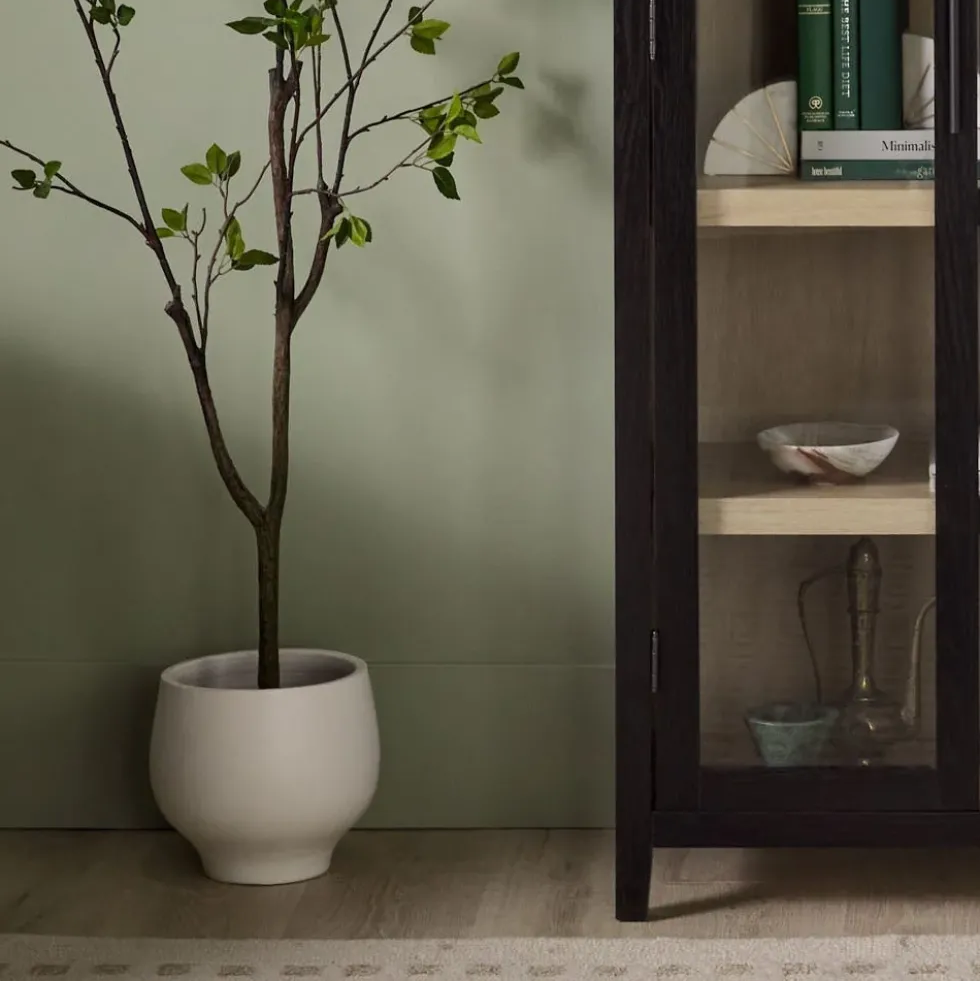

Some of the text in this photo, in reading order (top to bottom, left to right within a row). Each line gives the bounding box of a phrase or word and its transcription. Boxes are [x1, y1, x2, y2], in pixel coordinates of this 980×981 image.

[841, 17, 850, 43] BEST
[841, 46, 850, 68] LIFE
[841, 72, 850, 98] DIET
